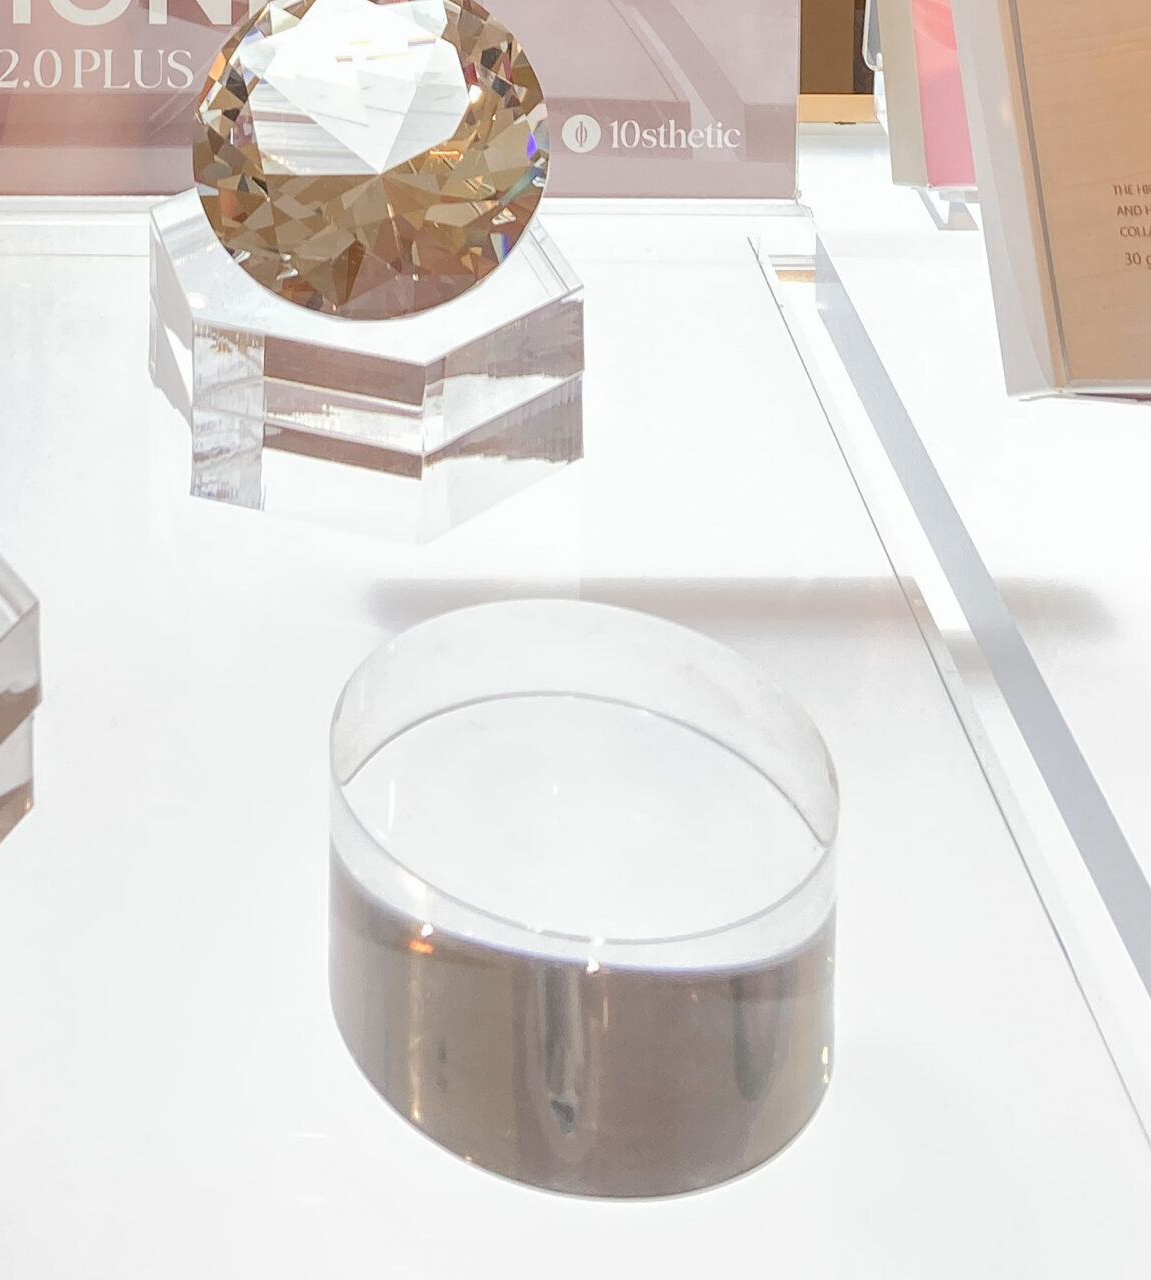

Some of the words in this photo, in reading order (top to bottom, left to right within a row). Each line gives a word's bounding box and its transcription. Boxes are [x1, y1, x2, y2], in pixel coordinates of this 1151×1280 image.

[72, 48, 194, 89] PLUS
[609, 119, 742, 149] 10sthetic
[1111, 184, 1135, 196] THE
[1116, 204, 1143, 217] AND
[1119, 226, 1151, 238] COLL
[1124, 251, 1142, 266] 30
